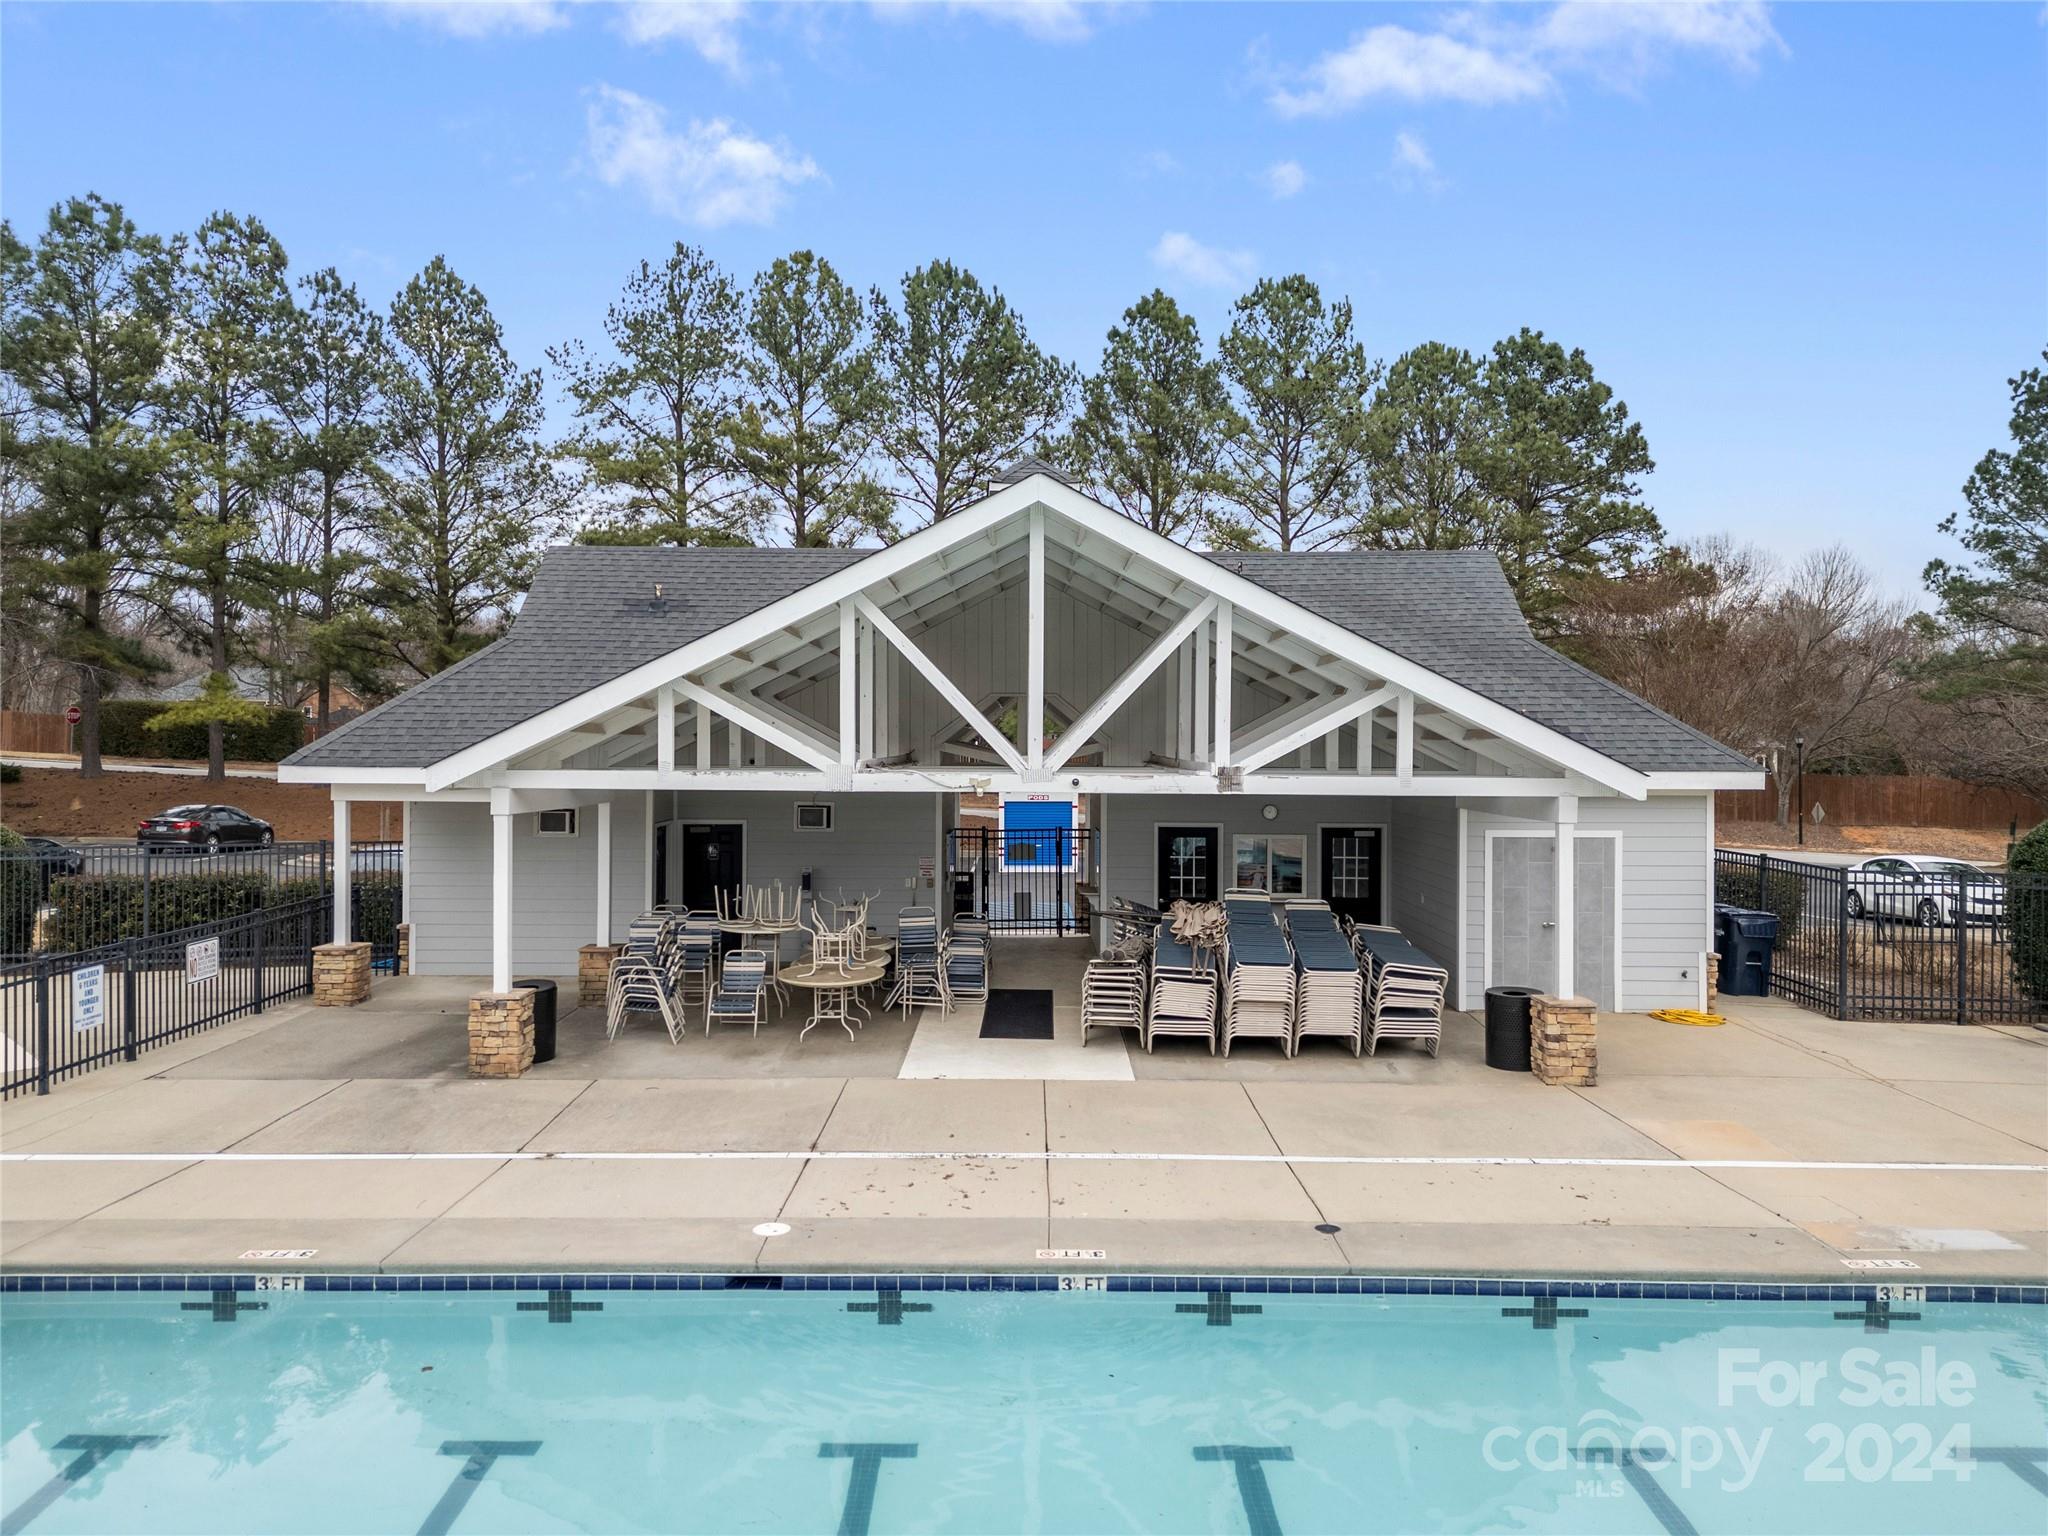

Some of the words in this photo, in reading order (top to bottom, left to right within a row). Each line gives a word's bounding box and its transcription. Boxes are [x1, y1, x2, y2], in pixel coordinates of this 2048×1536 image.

[77, 969, 99, 980] CHILDREN
[84, 978, 98, 988] YEARS
[84, 988, 93, 997] AND
[79, 996, 99, 1006] YOUNGER
[83, 1006, 94, 1015] ONLY
[281, 1276, 302, 1290] FT
[1085, 1277, 1104, 1291] FT
[1903, 1286, 1923, 1301] FT
